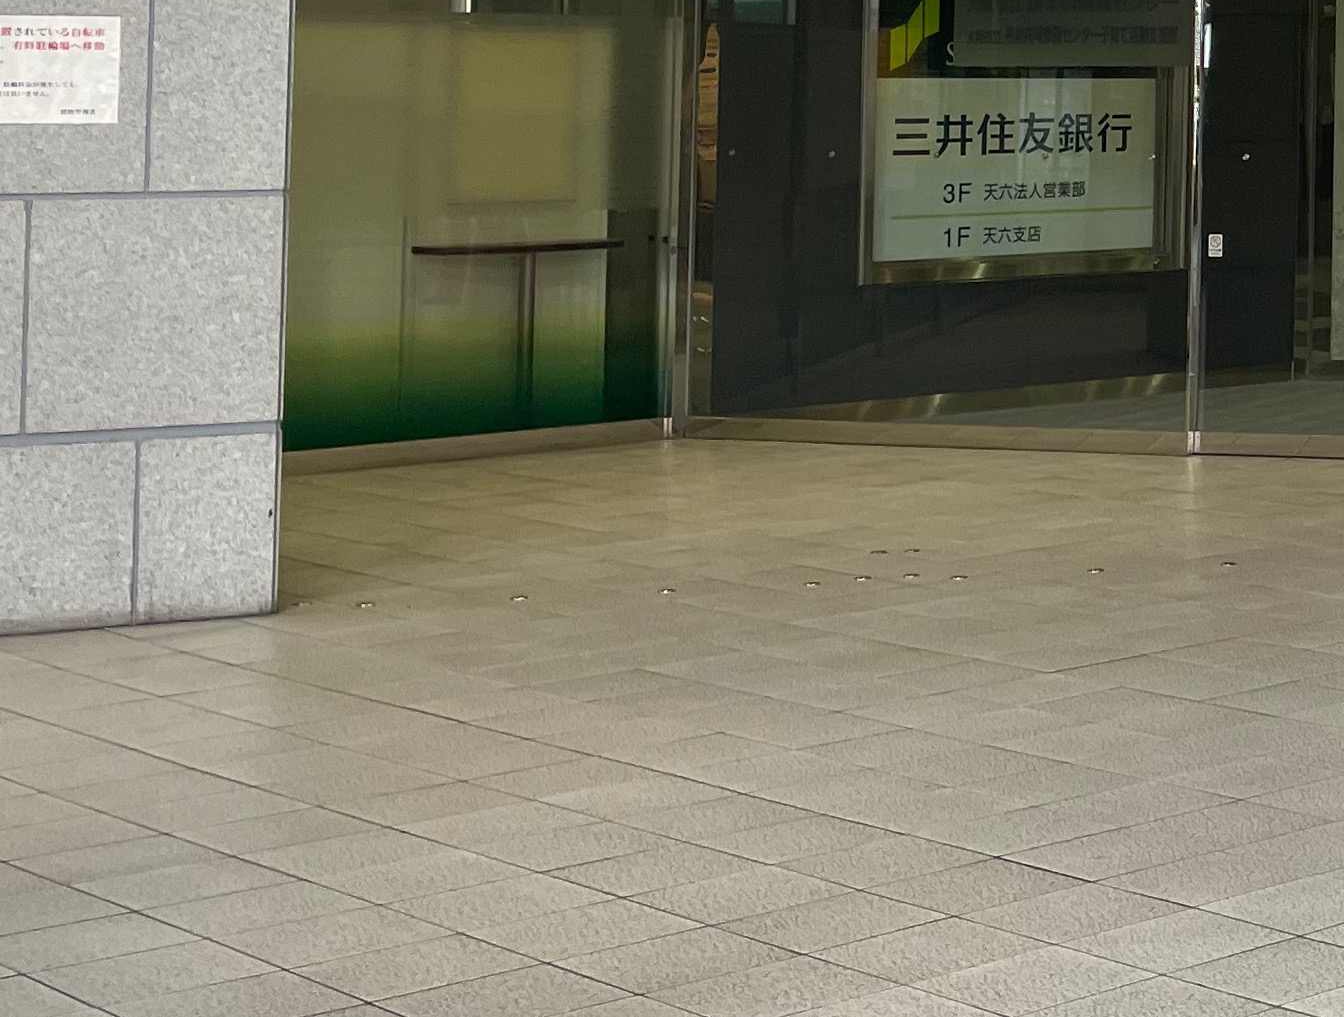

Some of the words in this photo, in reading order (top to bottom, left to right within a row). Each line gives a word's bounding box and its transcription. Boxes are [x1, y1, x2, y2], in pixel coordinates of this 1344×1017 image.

[892, 111, 1133, 157] 三井住友銀行
[943, 183, 972, 204] 3F
[983, 181, 1086, 202] 天六法人営業部
[943, 226, 972, 248] 1F
[982, 226, 1042, 245] 天六支店
